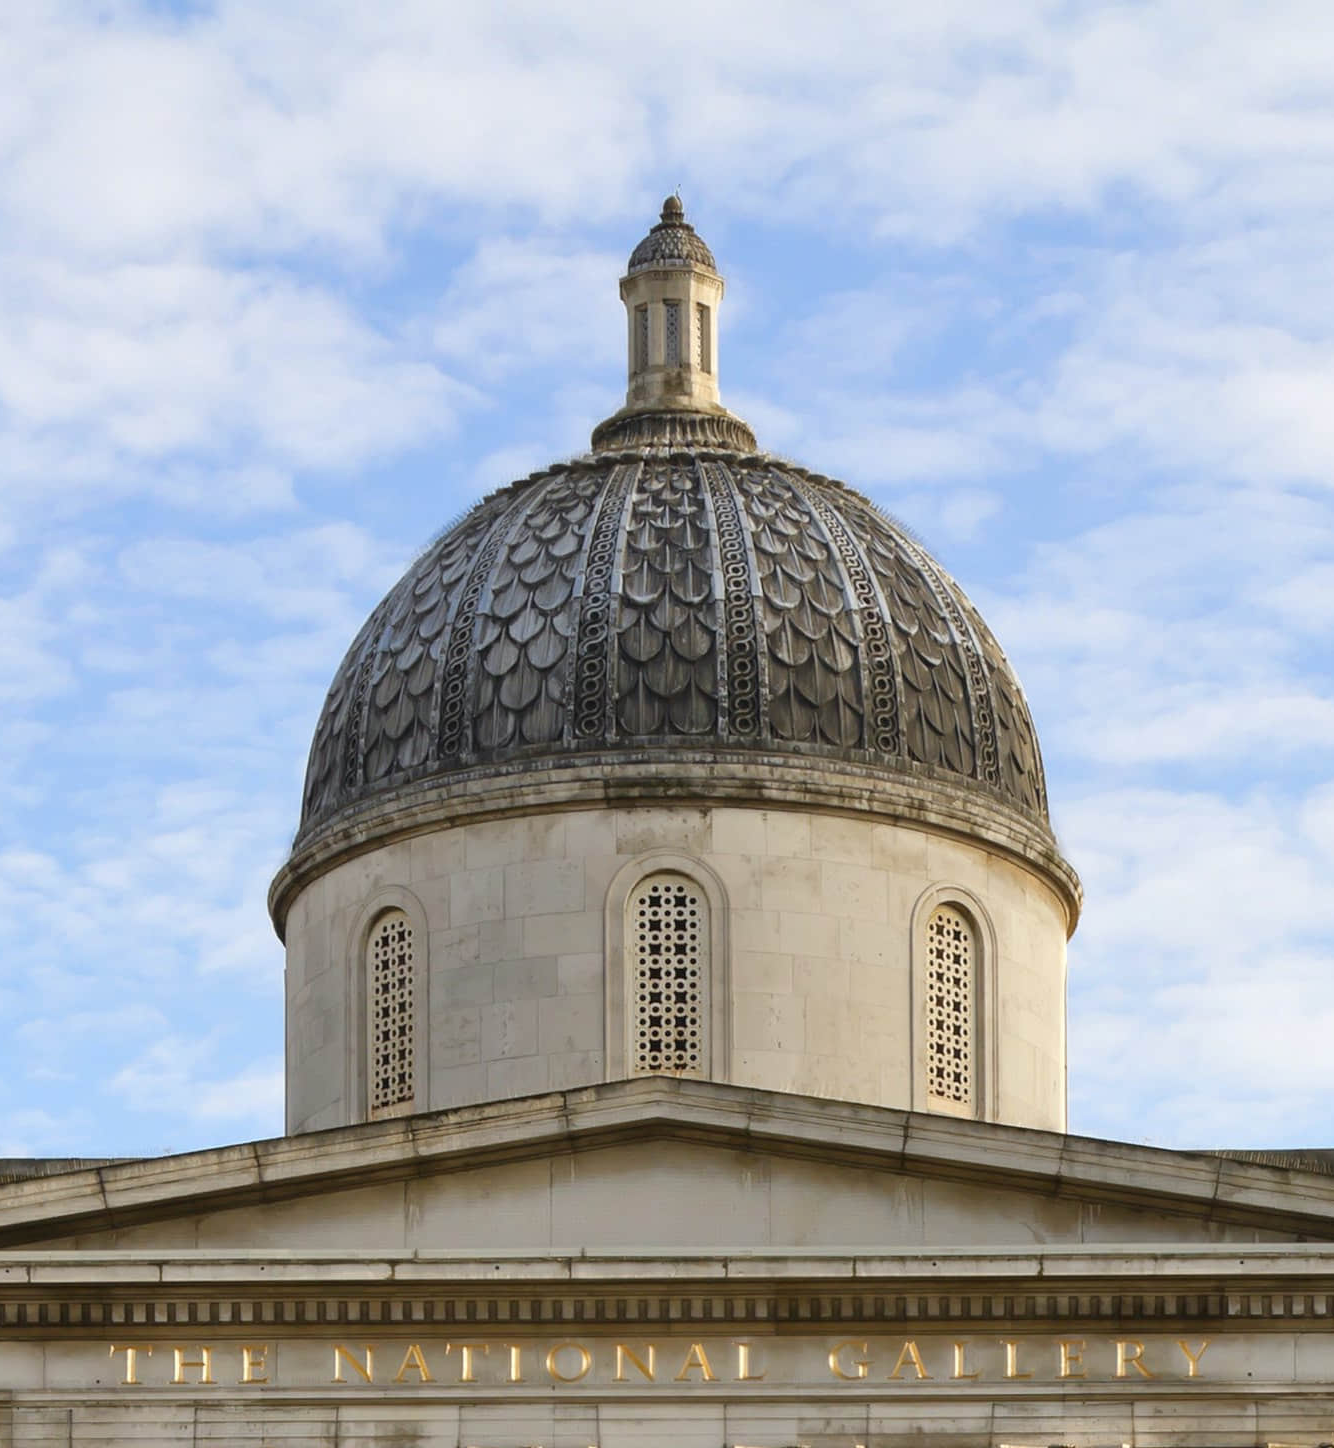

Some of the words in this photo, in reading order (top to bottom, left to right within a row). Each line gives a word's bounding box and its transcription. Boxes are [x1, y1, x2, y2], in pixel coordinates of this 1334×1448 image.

[109, 1344, 269, 1384] THE
[331, 1342, 767, 1384] NATIONAL
[827, 1338, 1209, 1381] GALLERY
